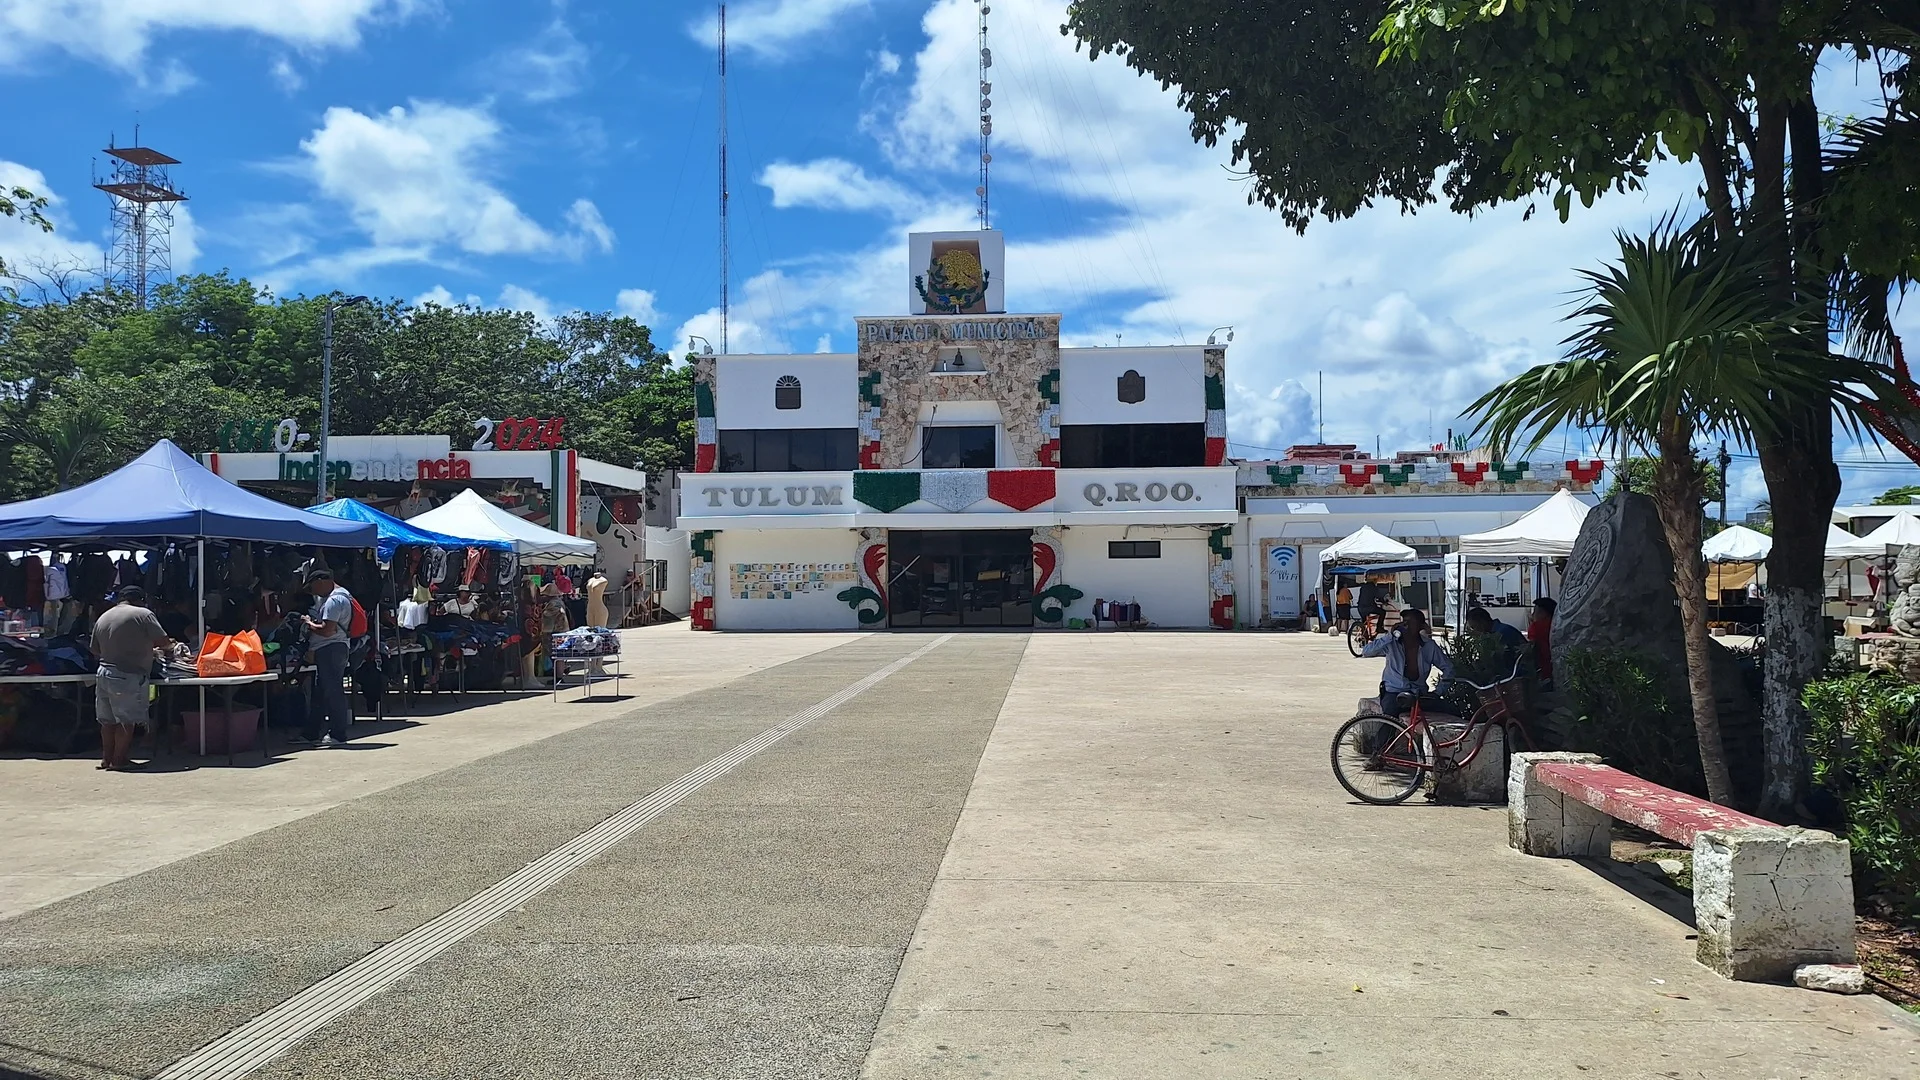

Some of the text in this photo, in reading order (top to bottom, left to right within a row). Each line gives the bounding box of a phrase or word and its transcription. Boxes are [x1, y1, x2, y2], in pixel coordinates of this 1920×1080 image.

[867, 321, 1048, 342] PALACIO MUNICIPAL
[471, 416, 566, 451] 2024
[278, 453, 472, 482] Independencia
[701, 486, 843, 507] TULUM
[1083, 482, 1202, 507] Q.ROO.
